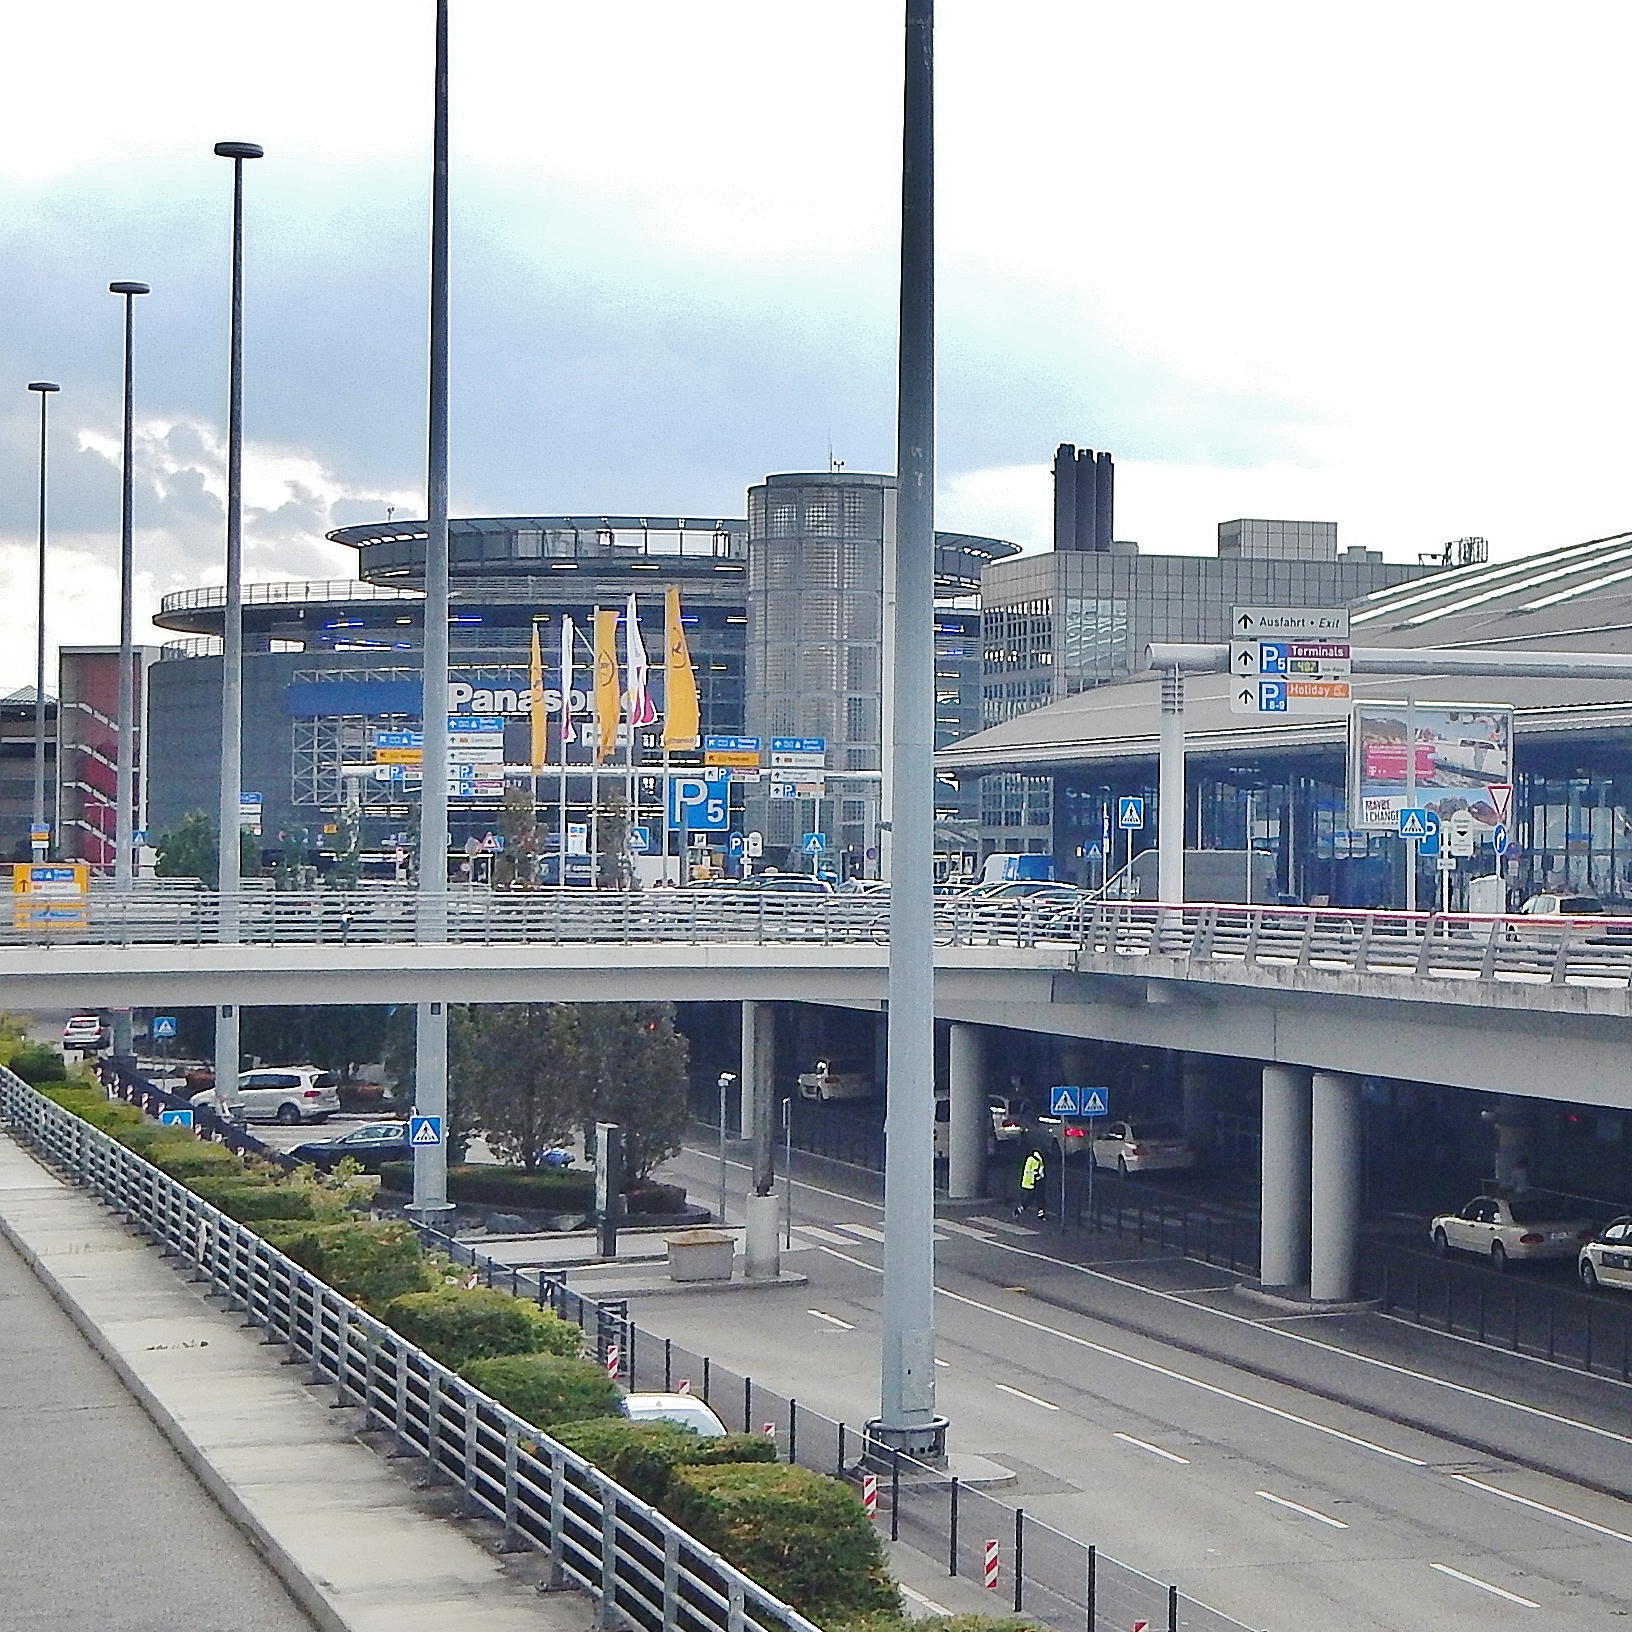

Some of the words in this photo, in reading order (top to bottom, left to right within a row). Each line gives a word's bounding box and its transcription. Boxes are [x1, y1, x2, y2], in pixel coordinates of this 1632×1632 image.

[1260, 616, 1305, 627] Ausfahrt
[1318, 617, 1340, 628] Exit
[1291, 645, 1344, 657] Terminals
[1290, 685, 1330, 697] Holiday
[447, 682, 642, 713] Panaso
[1365, 799, 1391, 811] MAYBE
[731, 837, 741, 851] P
